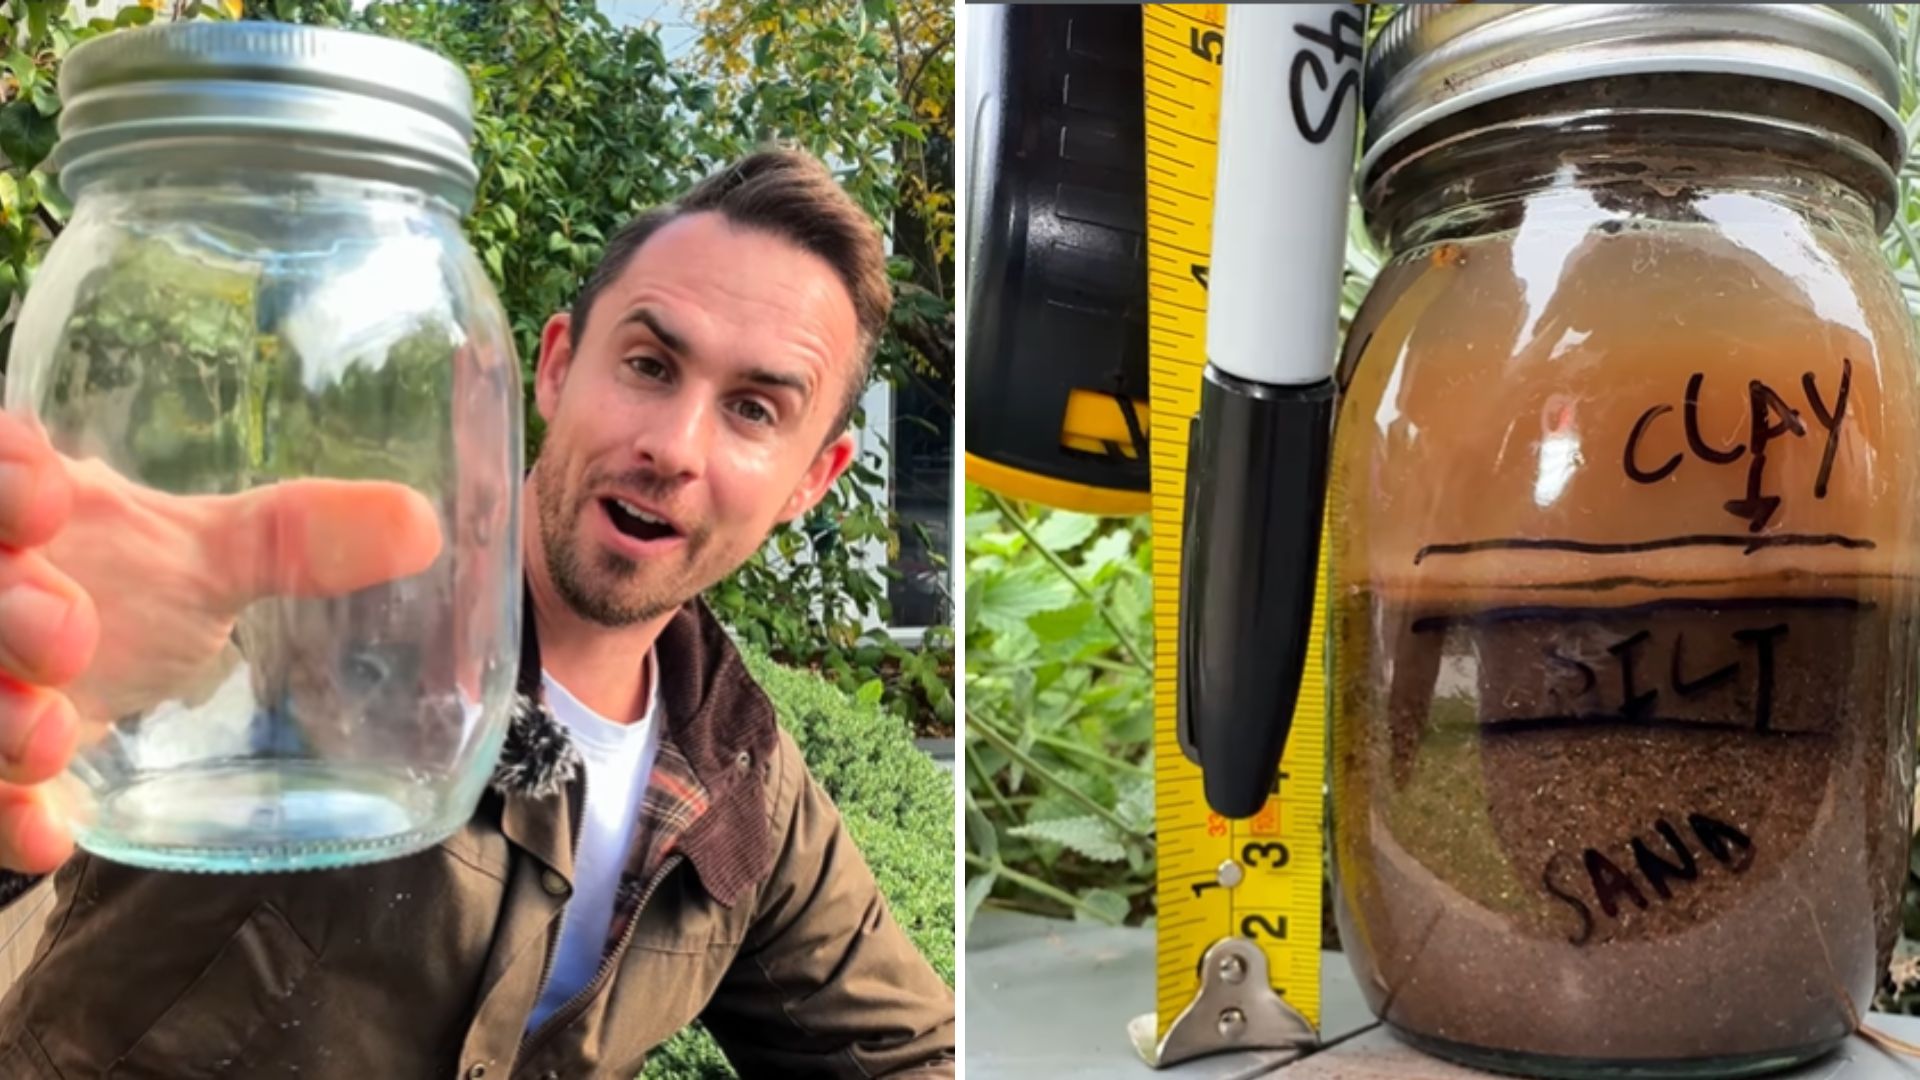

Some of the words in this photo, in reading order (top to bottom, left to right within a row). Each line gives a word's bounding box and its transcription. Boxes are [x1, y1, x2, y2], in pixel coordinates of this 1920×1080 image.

[1623, 357, 1852, 499] CLAY
[1546, 622, 1789, 734] SILT
[1242, 842, 1290, 868] 3
[1542, 813, 1756, 946] SAND
